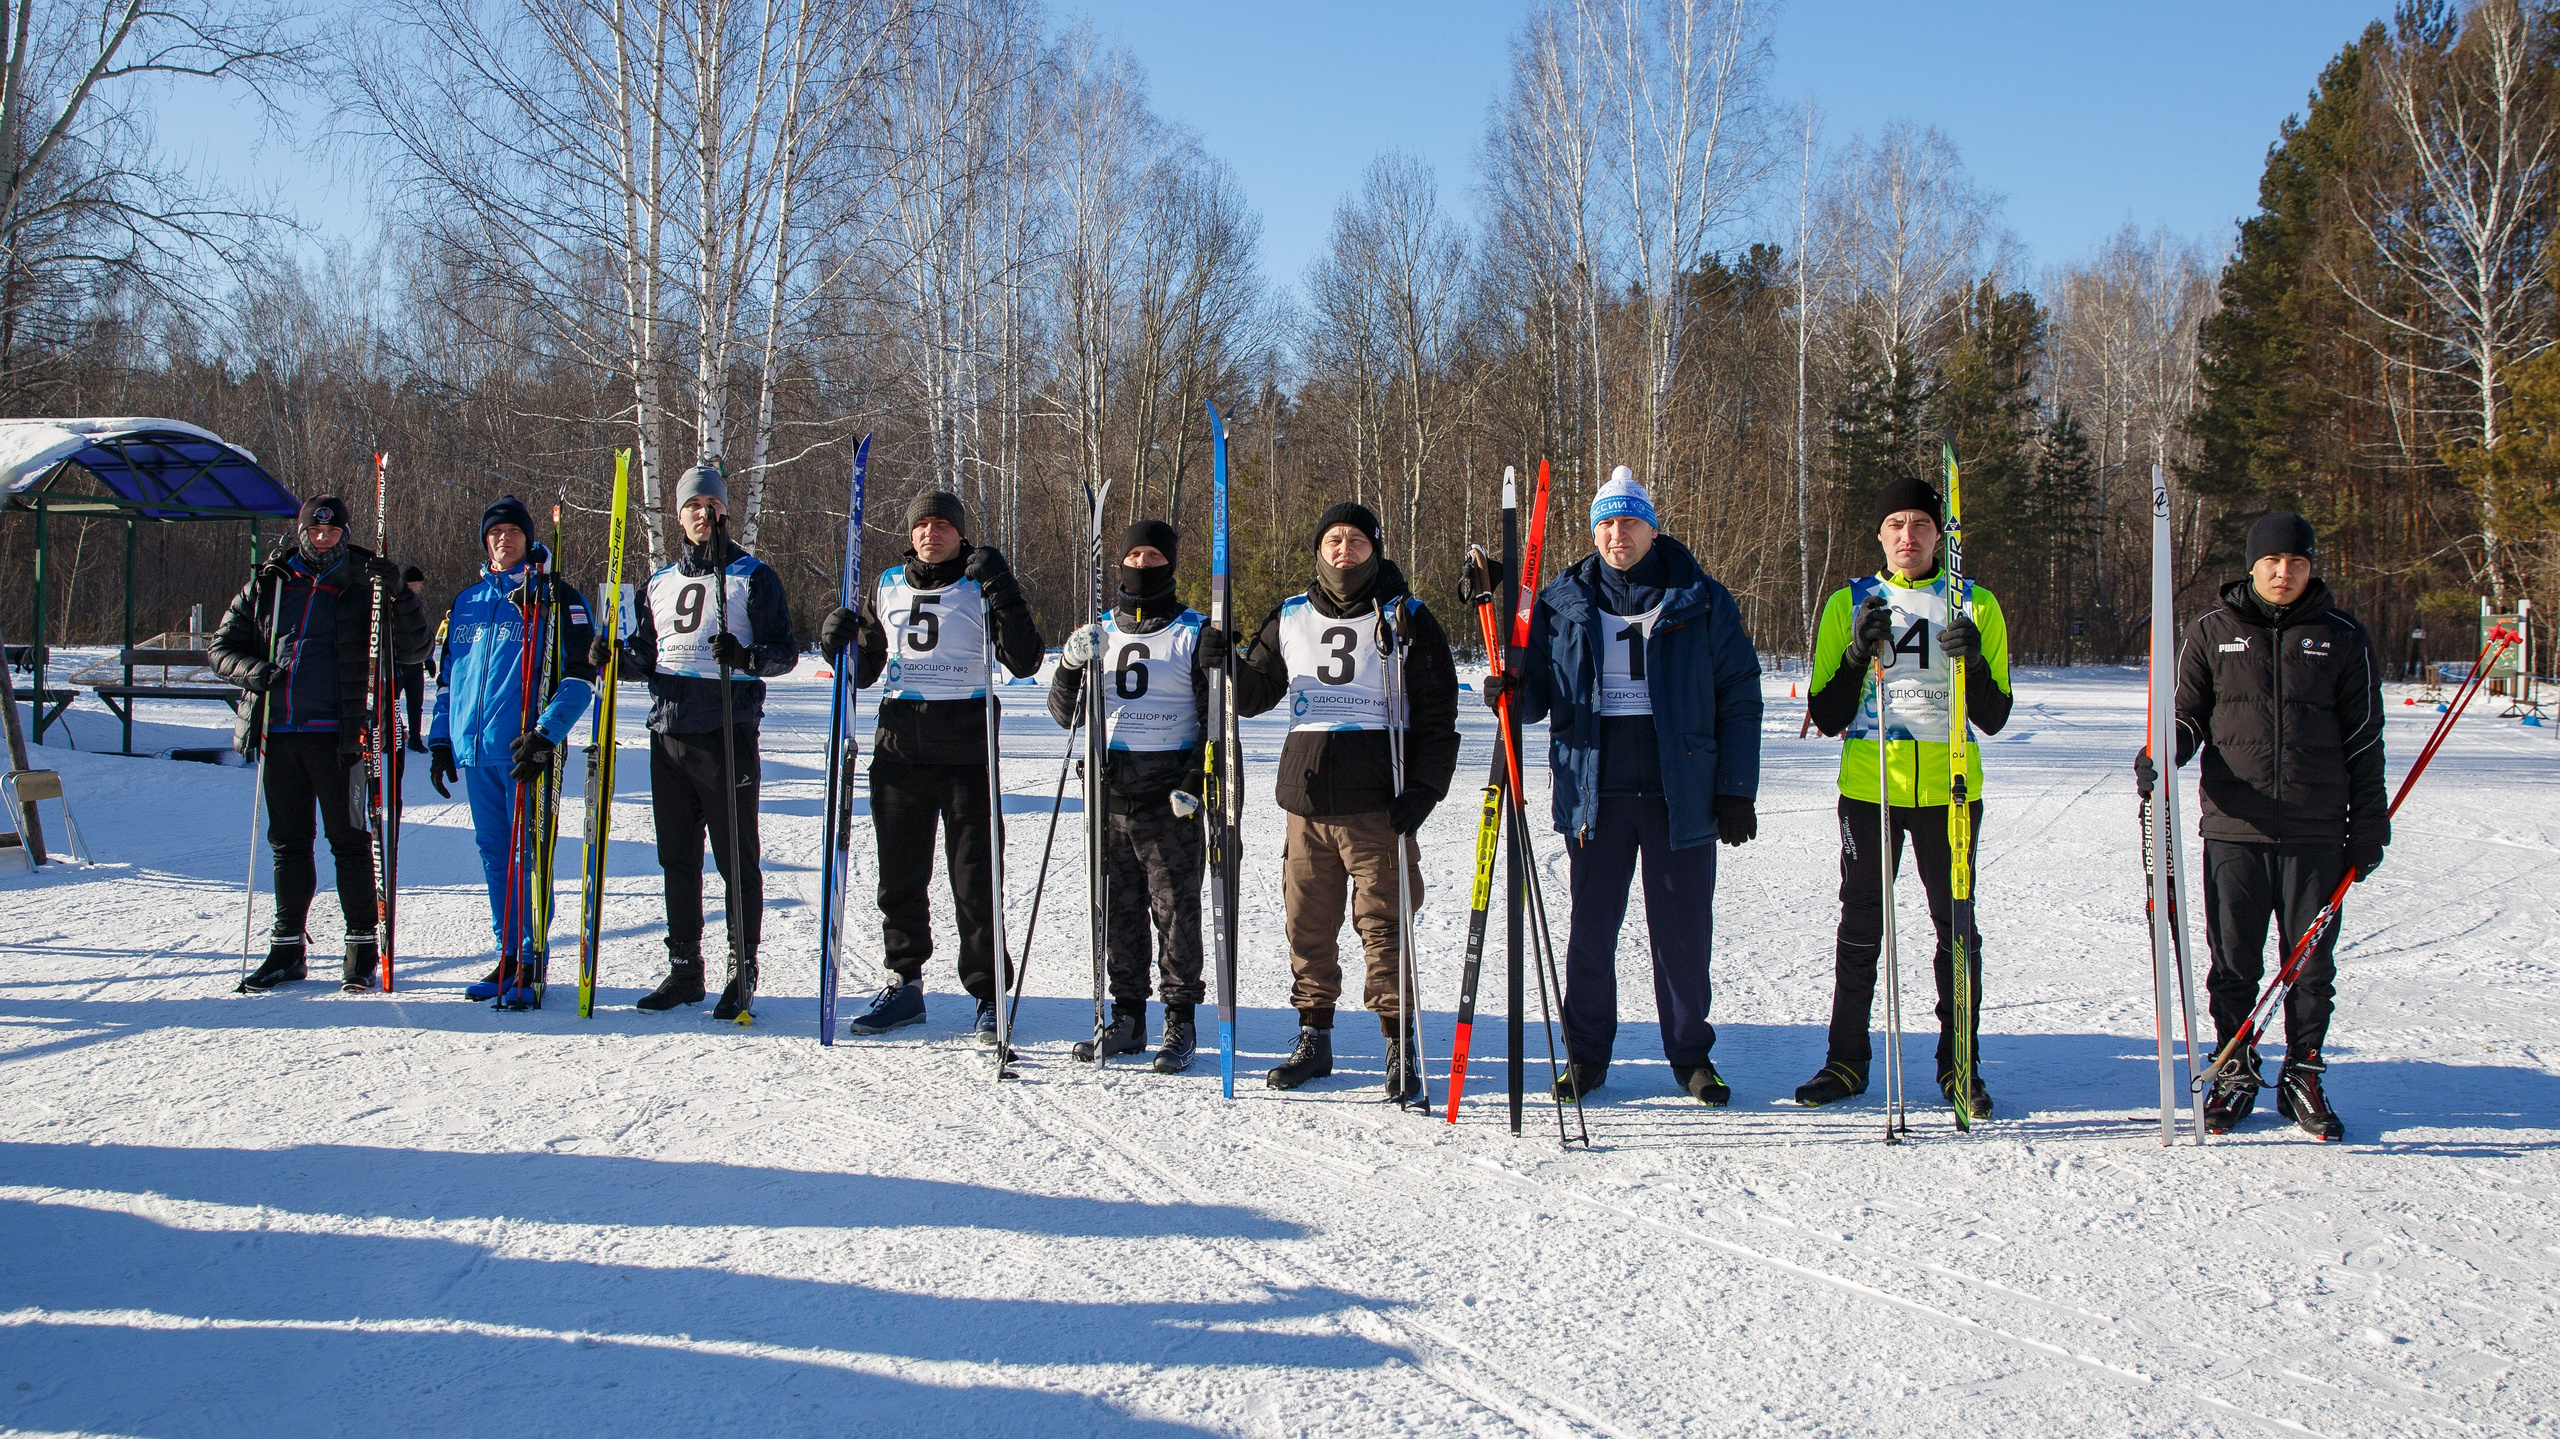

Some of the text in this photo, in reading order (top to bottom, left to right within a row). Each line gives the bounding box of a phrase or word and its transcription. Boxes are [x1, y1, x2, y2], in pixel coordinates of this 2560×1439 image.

[611, 517, 622, 585] FISCHER
[1525, 544, 1537, 590] ATOMIC
[674, 583, 706, 634] 9
[908, 595, 941, 652] 5
[667, 644, 710, 652] СДЮСШОР
[904, 663, 968, 674] СДЮСШОР №2
[1317, 626, 1357, 685] 3
[1616, 622, 1645, 681] 1
[1896, 618, 1929, 669] 4
[2219, 643, 2245, 652] PUMA
[1116, 642, 1150, 700] 6
[1889, 689, 1948, 700] СДЮСШОР
[394, 699, 402, 752] ROSSIGNOL
[1110, 711, 1178, 722] СДЮСШОР №2
[1312, 696, 1370, 705] СДЮСШОР
[372, 725, 381, 778] ROSSIGNOL
[549, 742, 562, 816] FISCHER
[537, 782, 546, 842] FISCHER
[2144, 799, 2154, 875] ROSSIGNOL
[1844, 816, 1857, 860] ТЮМЕНСКАЯ
[2296, 957, 2306, 972] WORLD
